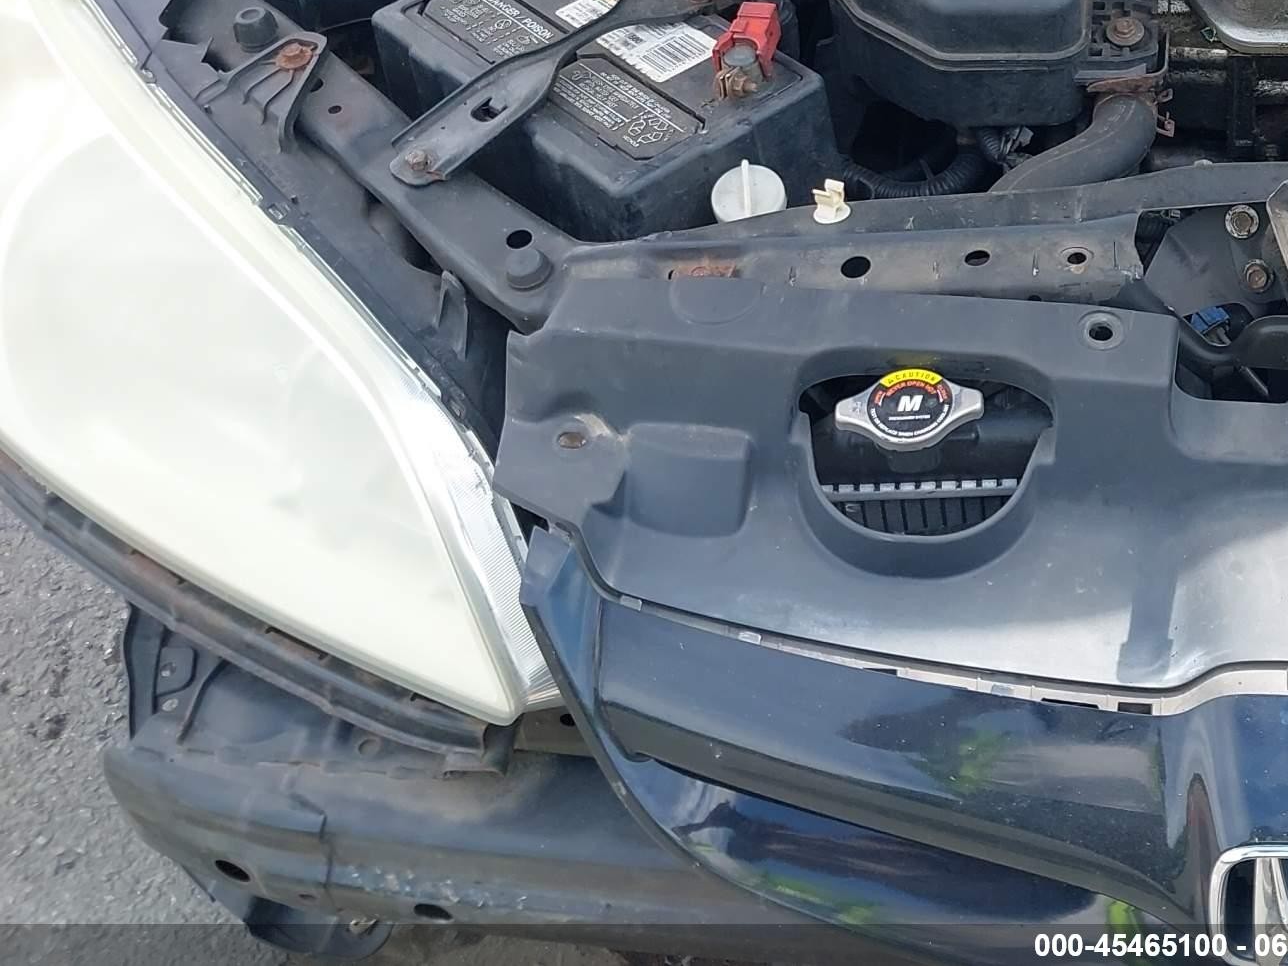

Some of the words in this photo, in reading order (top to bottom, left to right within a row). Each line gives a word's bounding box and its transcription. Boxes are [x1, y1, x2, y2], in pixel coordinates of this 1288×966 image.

[522, 18, 555, 40] POISON
[895, 371, 936, 382] CAUTION
[896, 394, 924, 412] M
